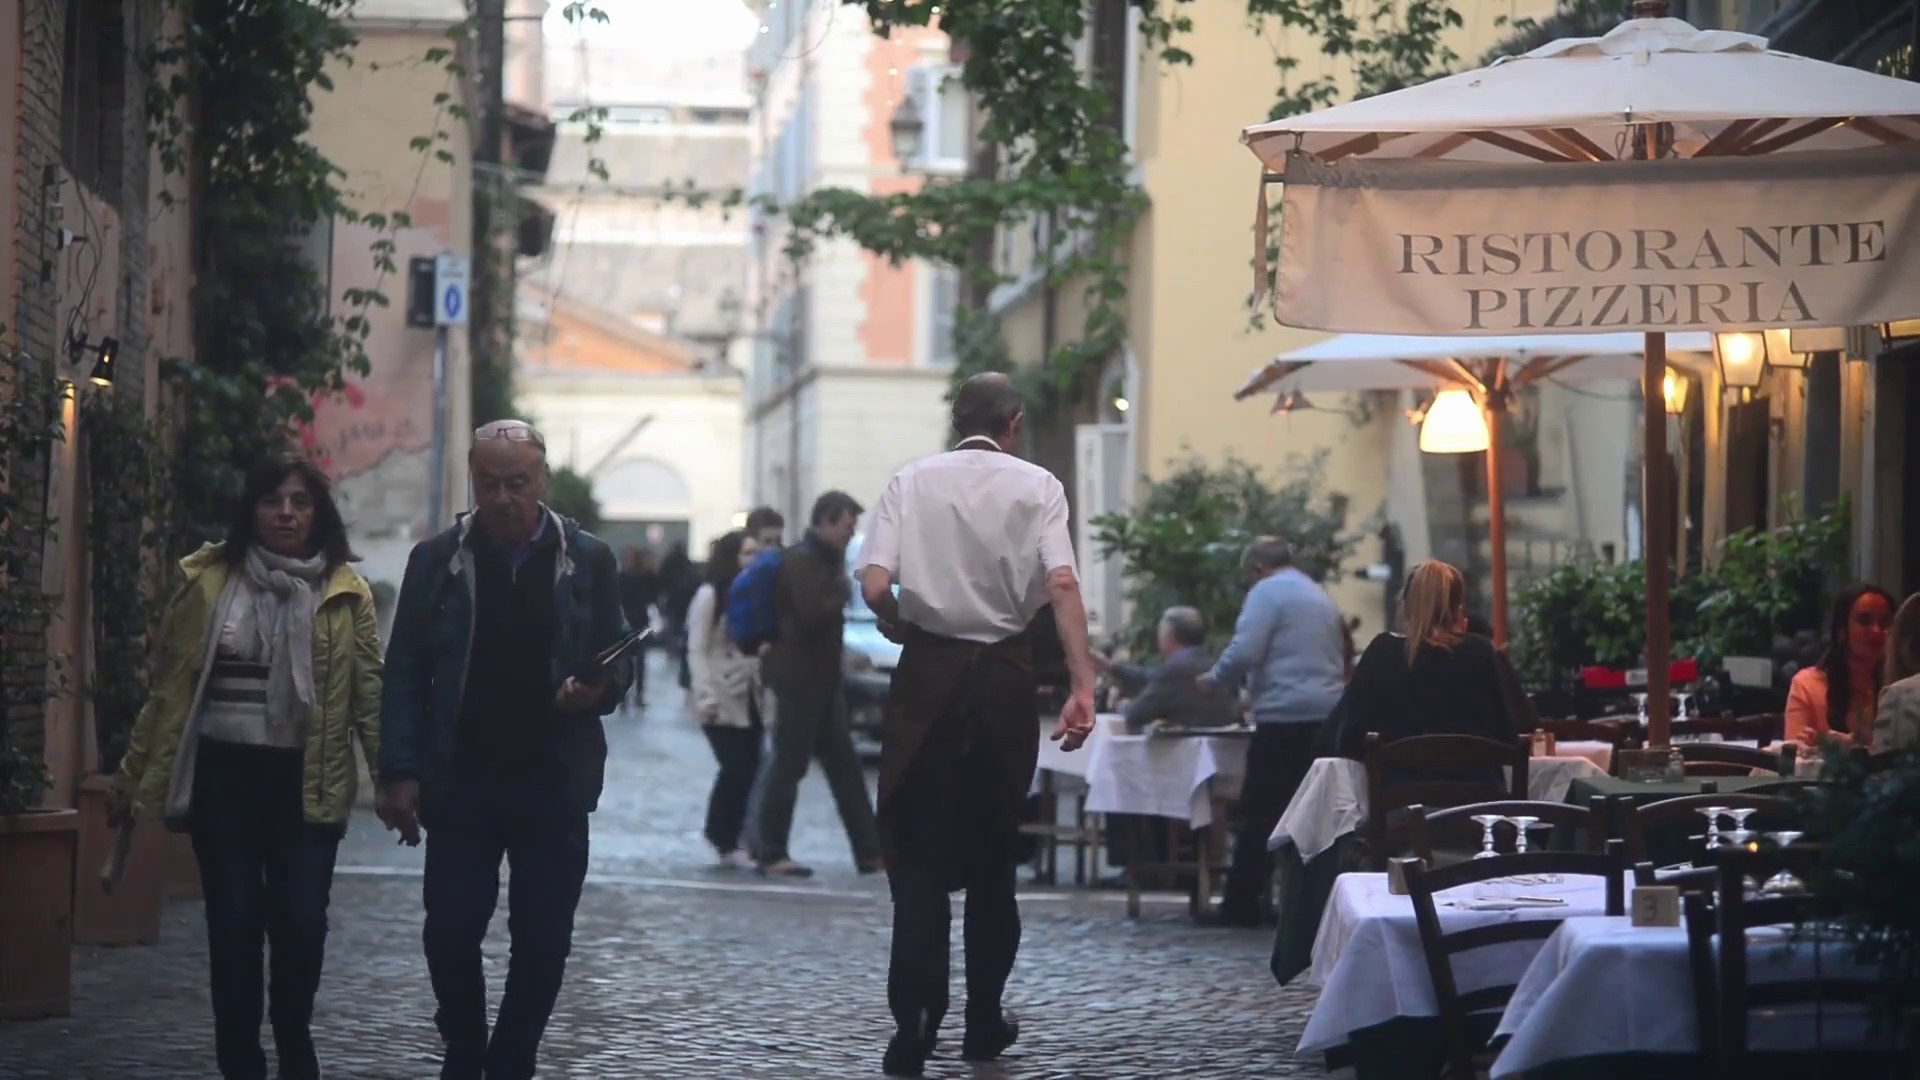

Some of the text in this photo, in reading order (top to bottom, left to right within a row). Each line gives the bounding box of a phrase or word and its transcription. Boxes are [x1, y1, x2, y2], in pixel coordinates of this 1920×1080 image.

[1396, 220, 1886, 275] RISTORANTE
[1462, 280, 1819, 330] PIZZERIA
[1642, 894, 1658, 922] 3
